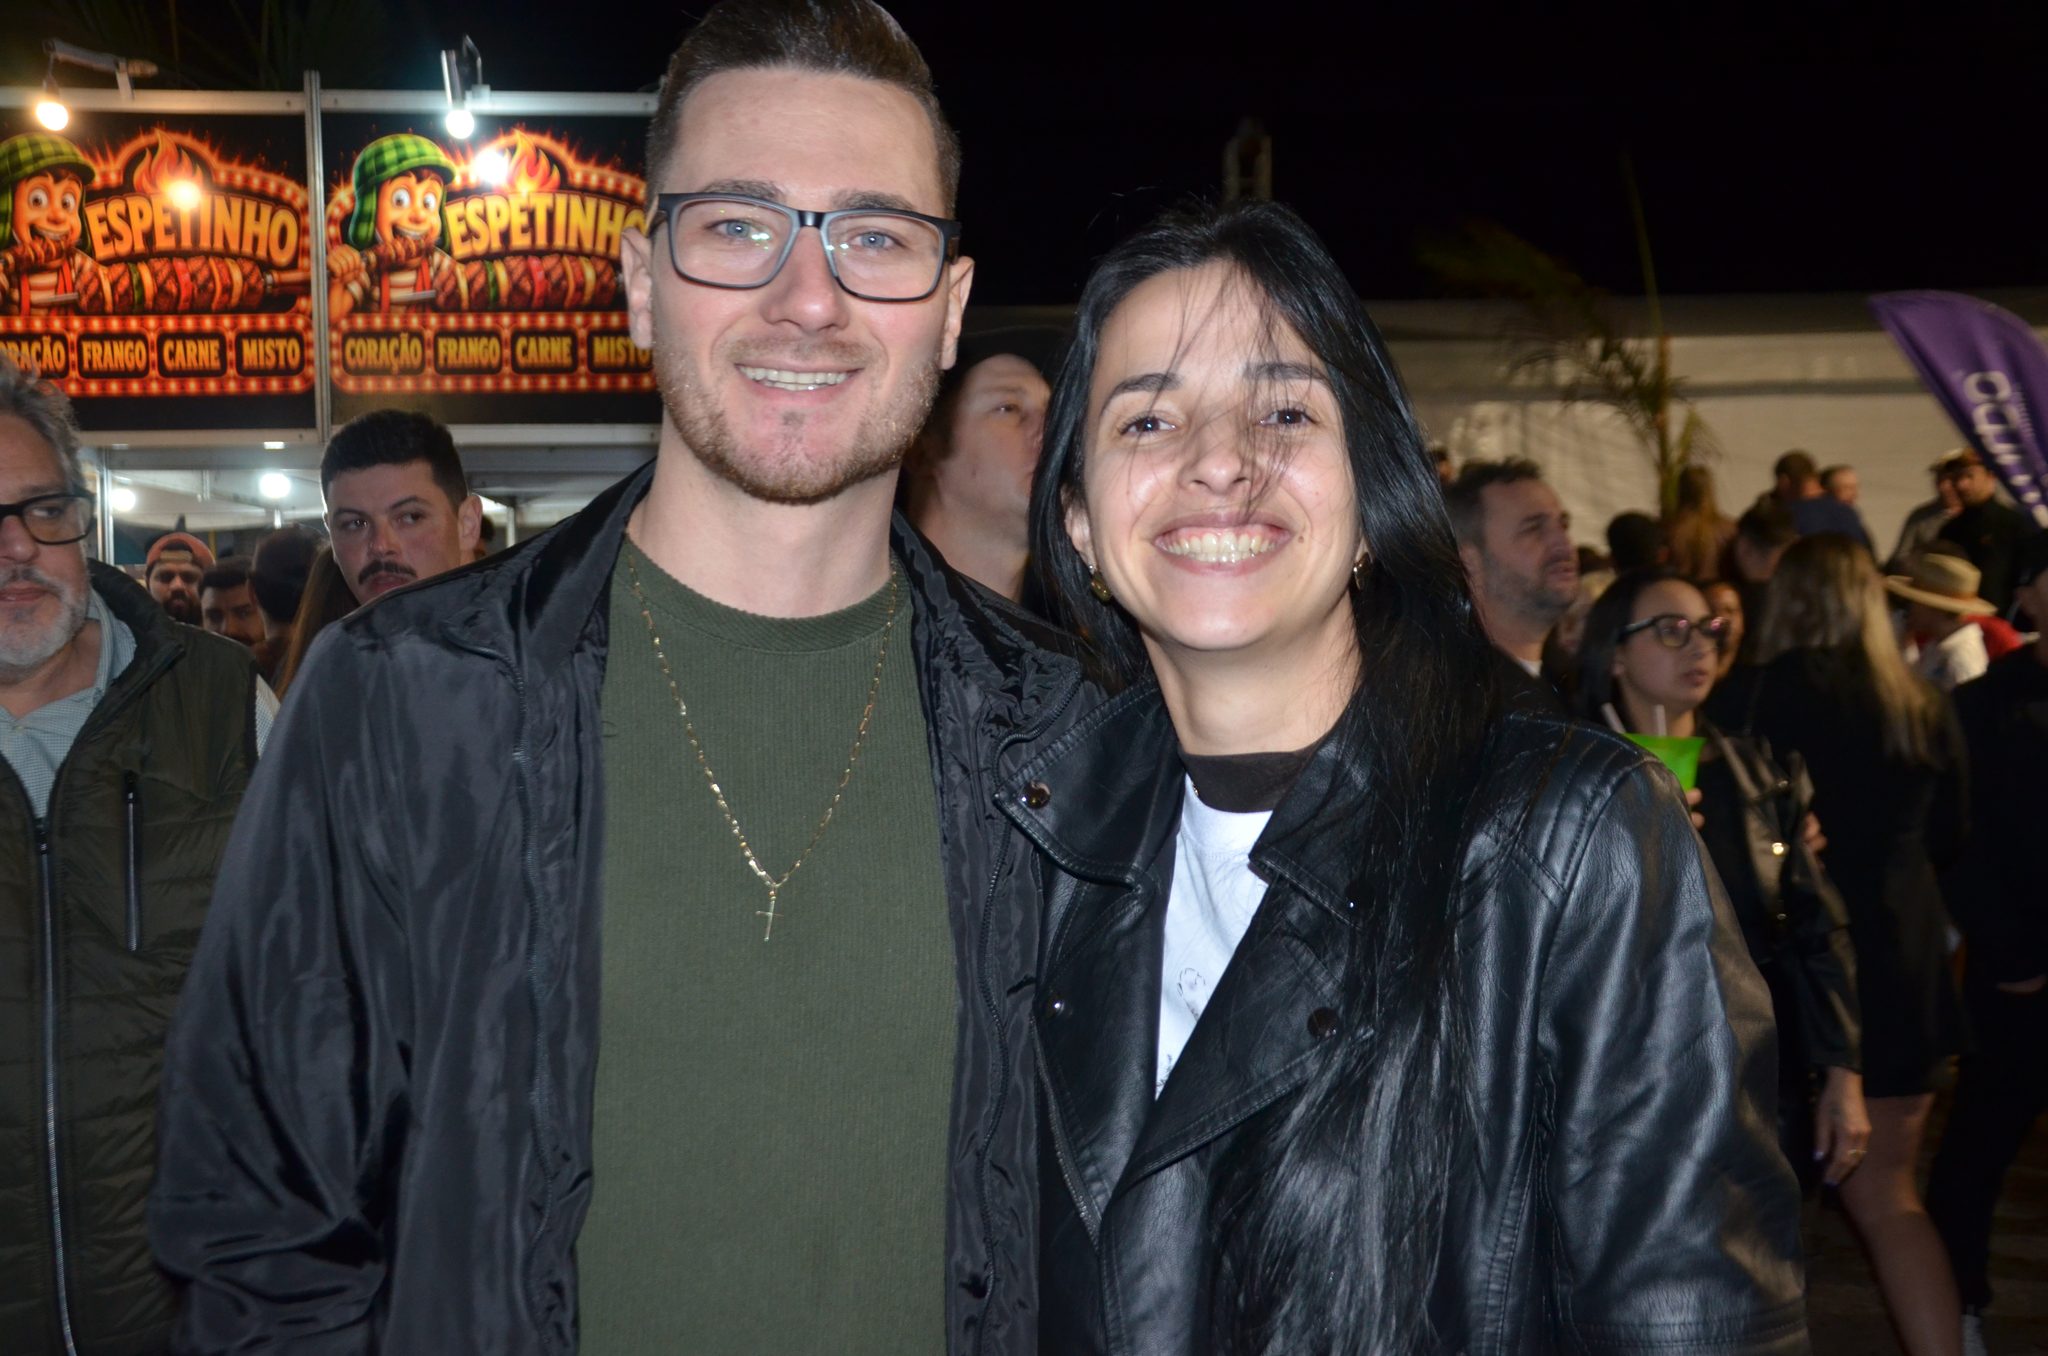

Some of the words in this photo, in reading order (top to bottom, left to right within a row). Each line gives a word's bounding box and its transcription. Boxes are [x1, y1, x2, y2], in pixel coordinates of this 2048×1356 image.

[86, 193, 299, 267] ESPETINHO
[0, 335, 66, 377] RAÇÃO
[82, 341, 147, 371] FRANGO
[163, 340, 220, 370] CARNE
[242, 339, 301, 369] MISTO
[345, 333, 422, 373] CORAÇÃO
[438, 337, 500, 367] FRANGO
[516, 337, 572, 366] CARNE
